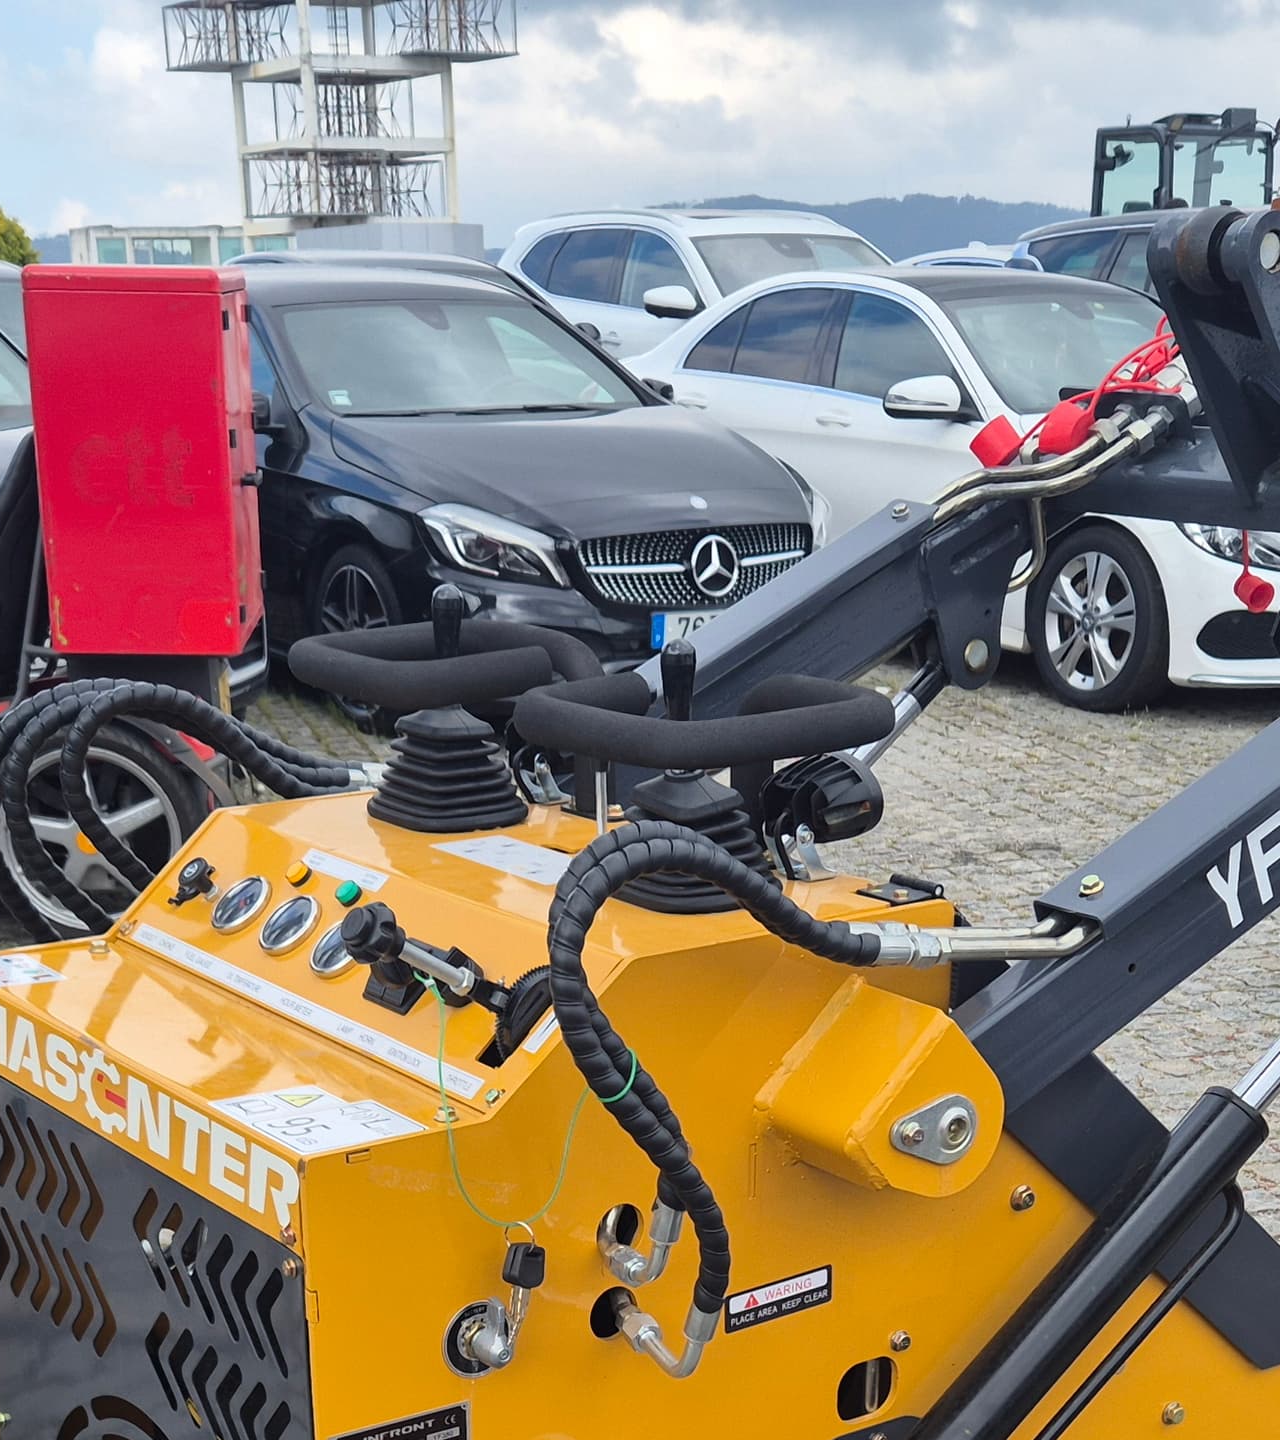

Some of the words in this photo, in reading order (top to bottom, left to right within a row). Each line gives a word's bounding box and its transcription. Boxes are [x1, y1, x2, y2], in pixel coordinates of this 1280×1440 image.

[268, 1116, 331, 1137] 95
[765, 1278, 812, 1301] WARING
[731, 1312, 755, 1327] PLACE
[757, 1305, 778, 1318] AREA
[782, 1298, 802, 1311] KEEP
[804, 1289, 828, 1304] CLEAR
